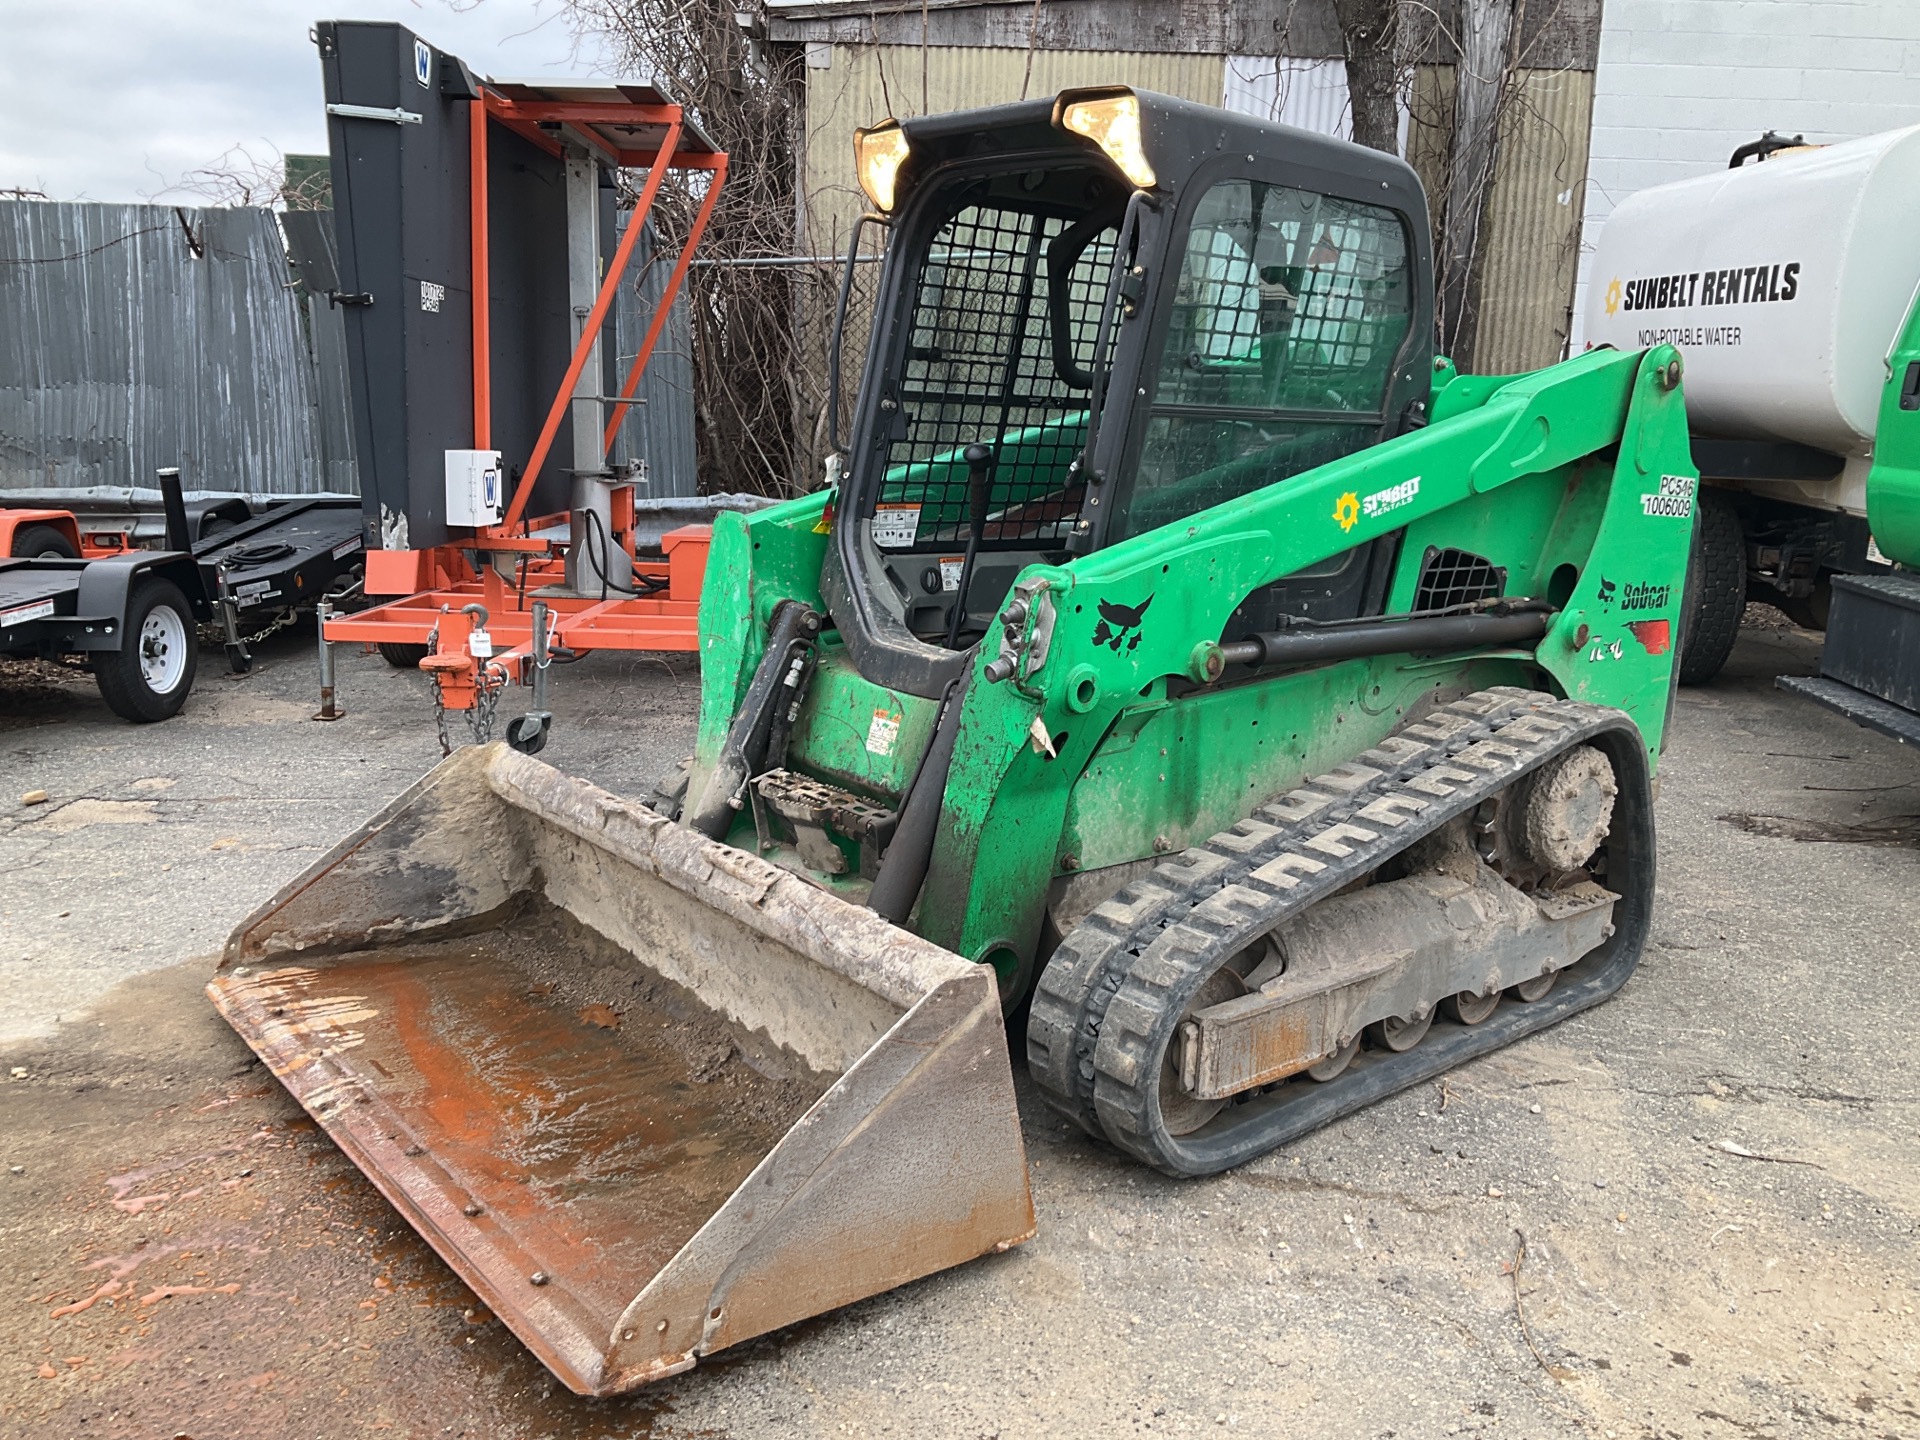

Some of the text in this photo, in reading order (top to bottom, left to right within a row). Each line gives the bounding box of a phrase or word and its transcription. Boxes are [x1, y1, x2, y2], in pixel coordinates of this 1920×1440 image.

[416, 45, 428, 79] W
[1623, 262, 1800, 311] SUNBELT RENTALS
[1638, 326, 1741, 347] NON-POTABLE WATER
[485, 475, 495, 502] W
[1660, 476, 1695, 497] PC546
[1646, 496, 1691, 517] 1006009
